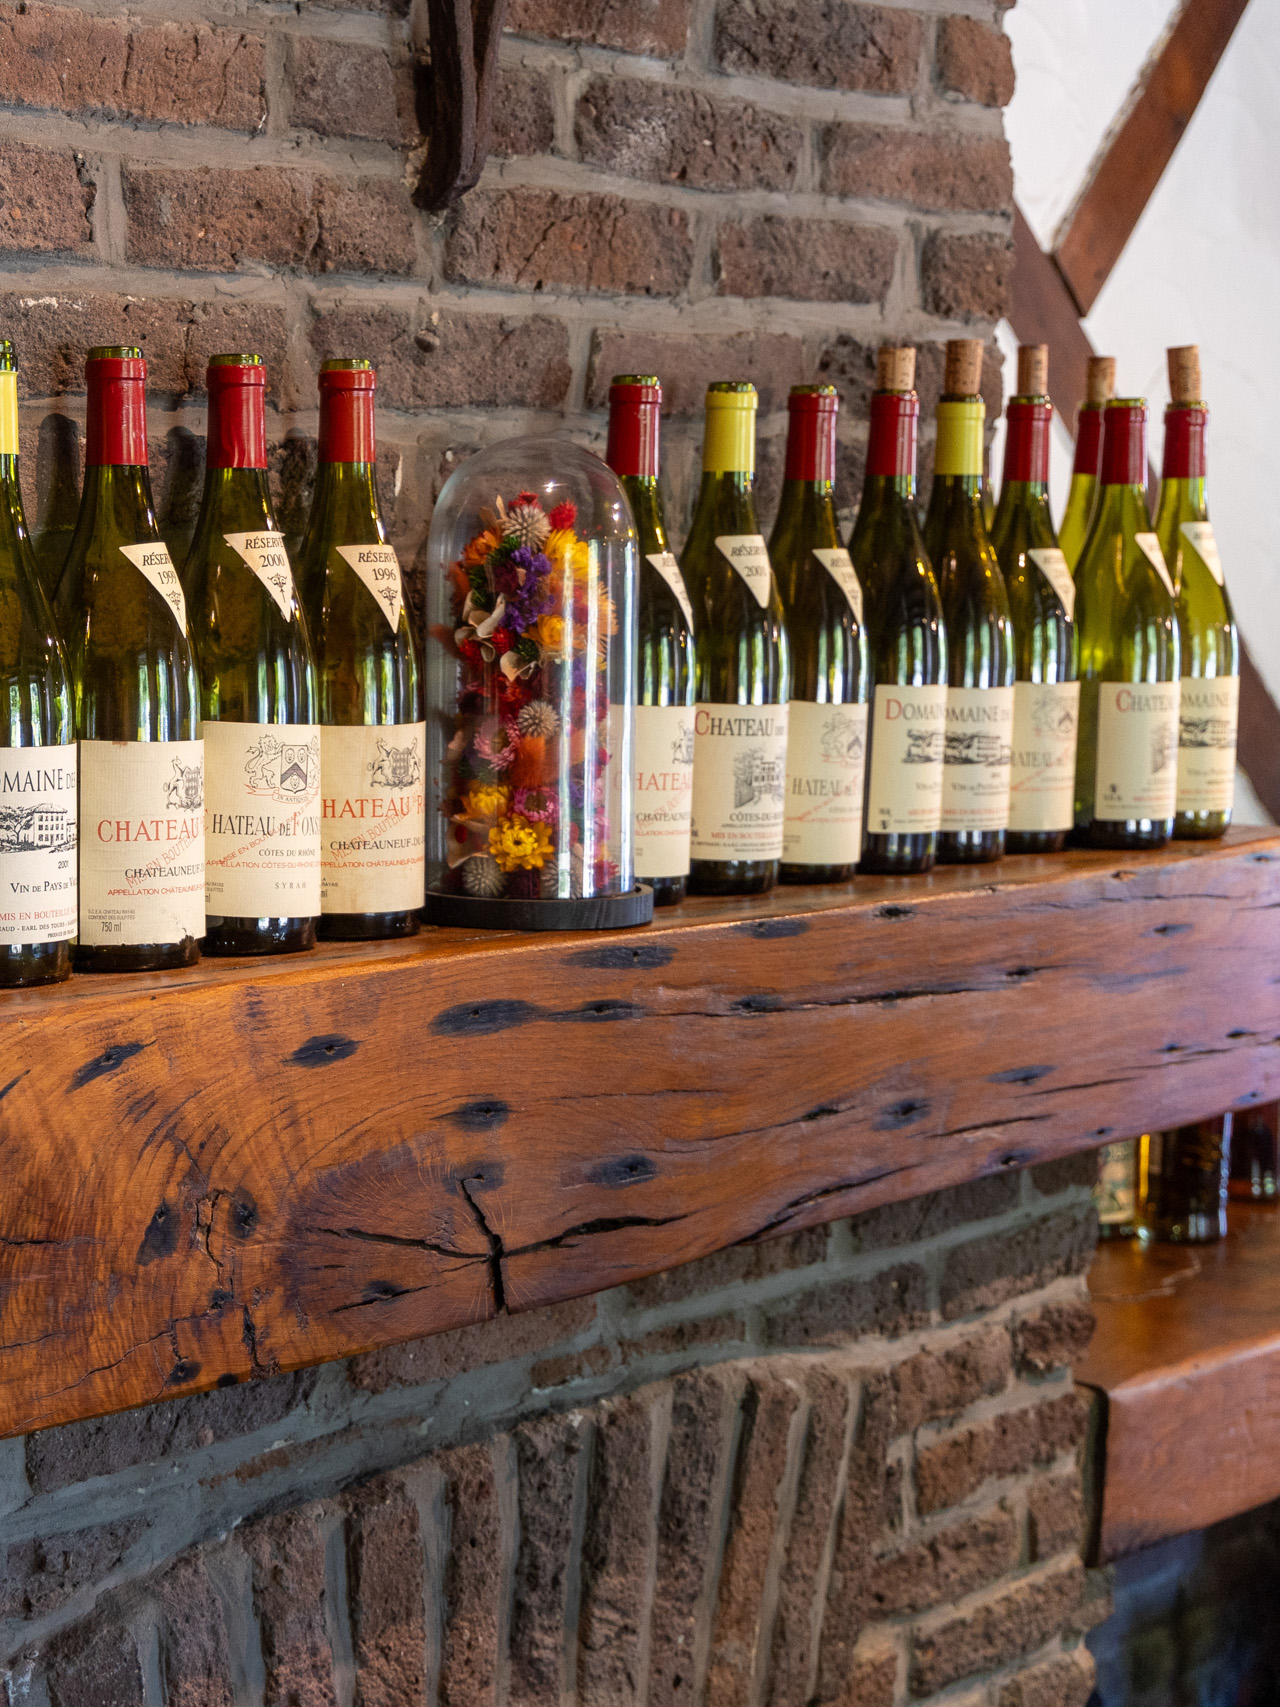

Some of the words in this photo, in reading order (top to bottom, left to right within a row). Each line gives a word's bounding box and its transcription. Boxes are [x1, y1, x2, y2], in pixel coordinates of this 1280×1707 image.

[259, 553, 285, 567] 2000
[372, 568, 396, 581] 1996
[695, 709, 774, 736] CHATEAU
[97, 817, 199, 843] CHATEAU
[212, 814, 275, 836] HATEAU
[258, 848, 285, 857] CÔTES
[286, 849, 297, 857] DU
[10, 883, 30, 894] VIN
[32, 885, 42, 893] DE
[43, 881, 62, 892] PAYS
[107, 888, 160, 896] APPELLATION
[20, 911, 31, 920] EN
[101, 922, 113, 932] 750
[114, 921, 122, 932] ml
